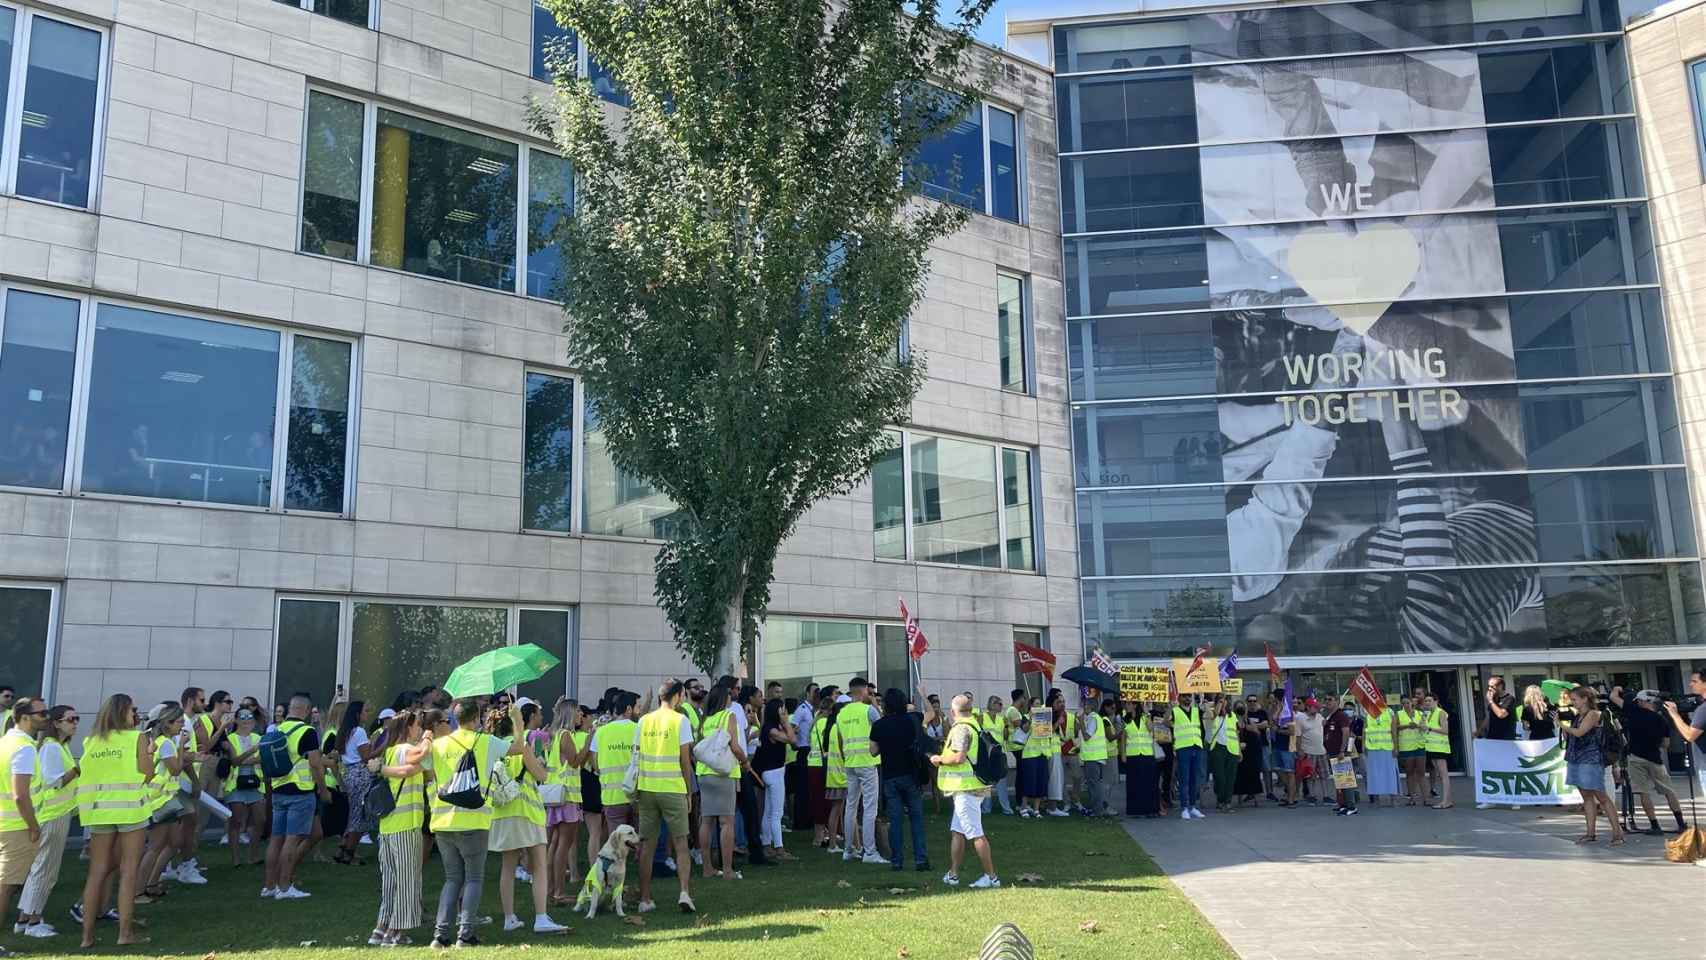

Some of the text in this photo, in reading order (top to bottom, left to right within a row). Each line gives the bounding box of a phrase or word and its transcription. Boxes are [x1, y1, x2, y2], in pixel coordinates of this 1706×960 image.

[1319, 182, 1375, 211] WE
[1283, 347, 1447, 386] WORKING
[1275, 388, 1463, 427] TOGETHER
[1080, 470, 1130, 485] Vsion
[1143, 691, 1167, 701] 2017
[91, 748, 122, 758] vueling
[1481, 769, 1574, 796] STAVL
